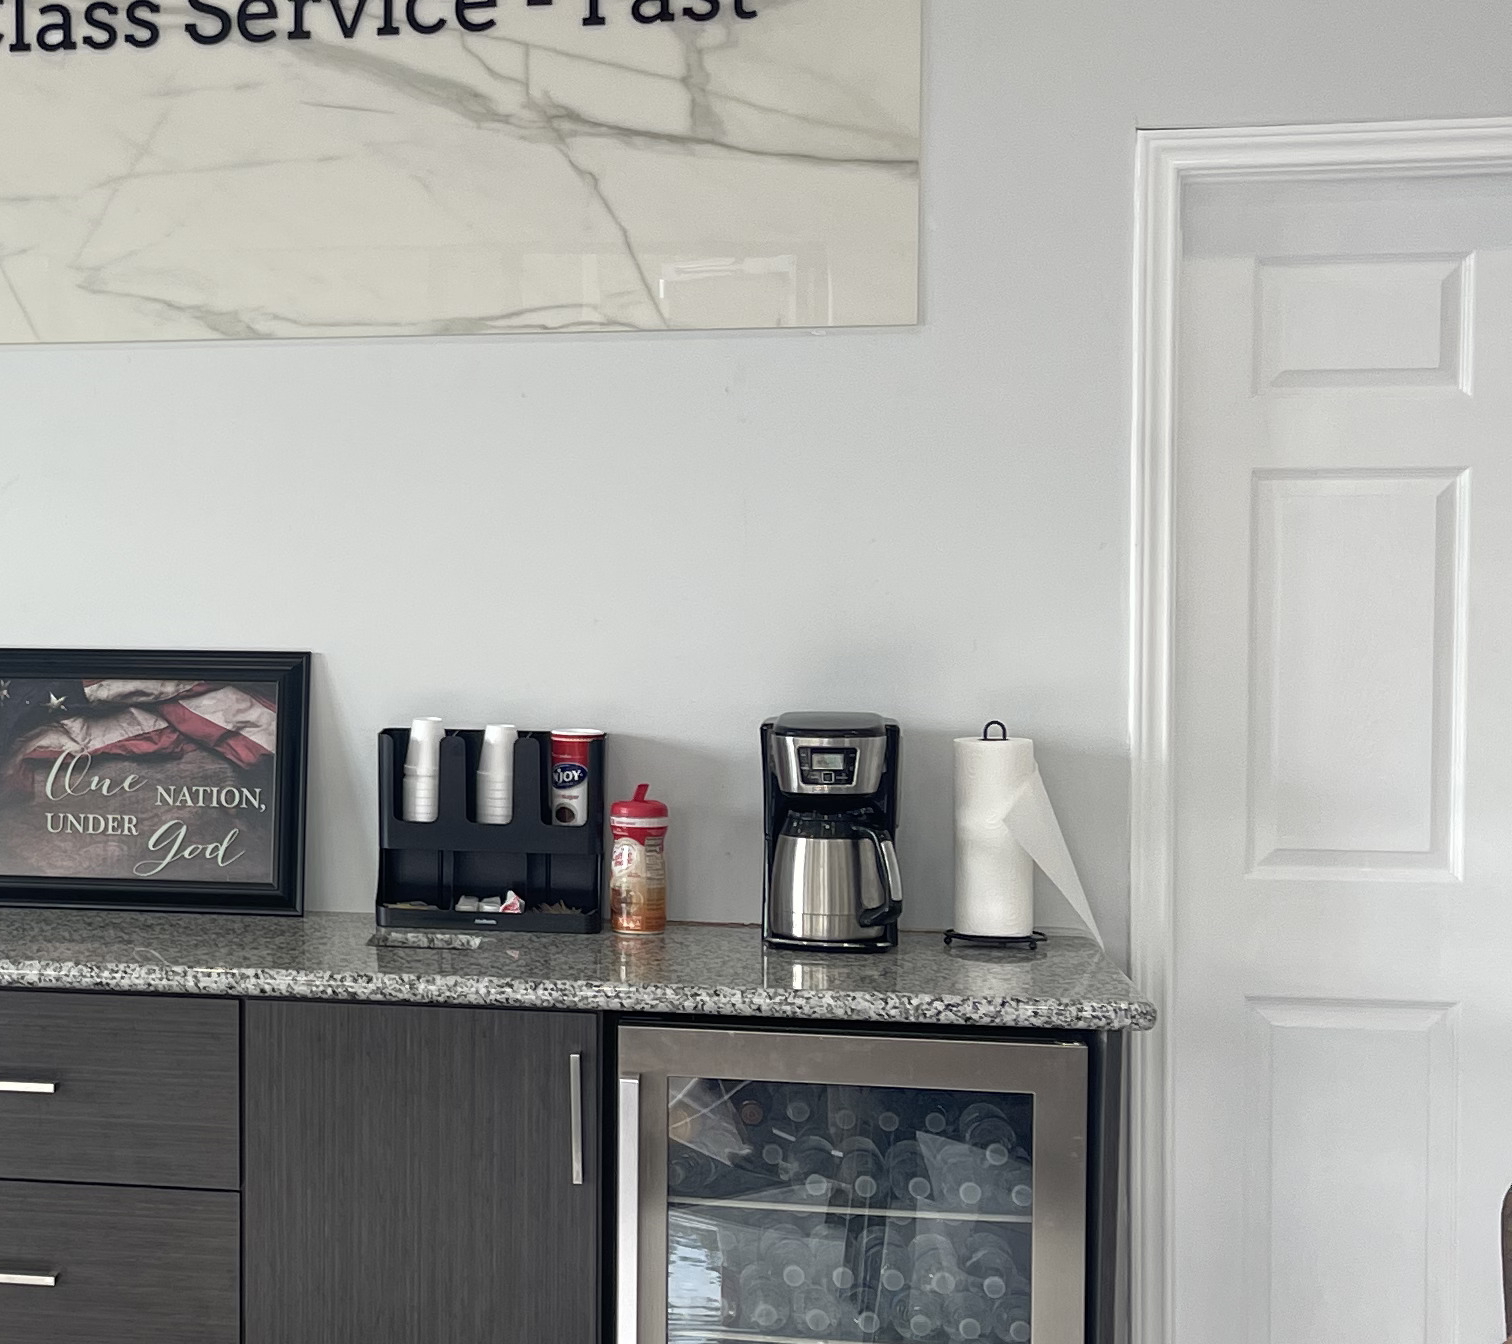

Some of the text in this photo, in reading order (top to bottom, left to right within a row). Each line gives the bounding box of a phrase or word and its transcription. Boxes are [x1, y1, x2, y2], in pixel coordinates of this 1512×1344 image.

[45, 748, 266, 812] One NATION,
[45, 812, 245, 877] UNDER God
